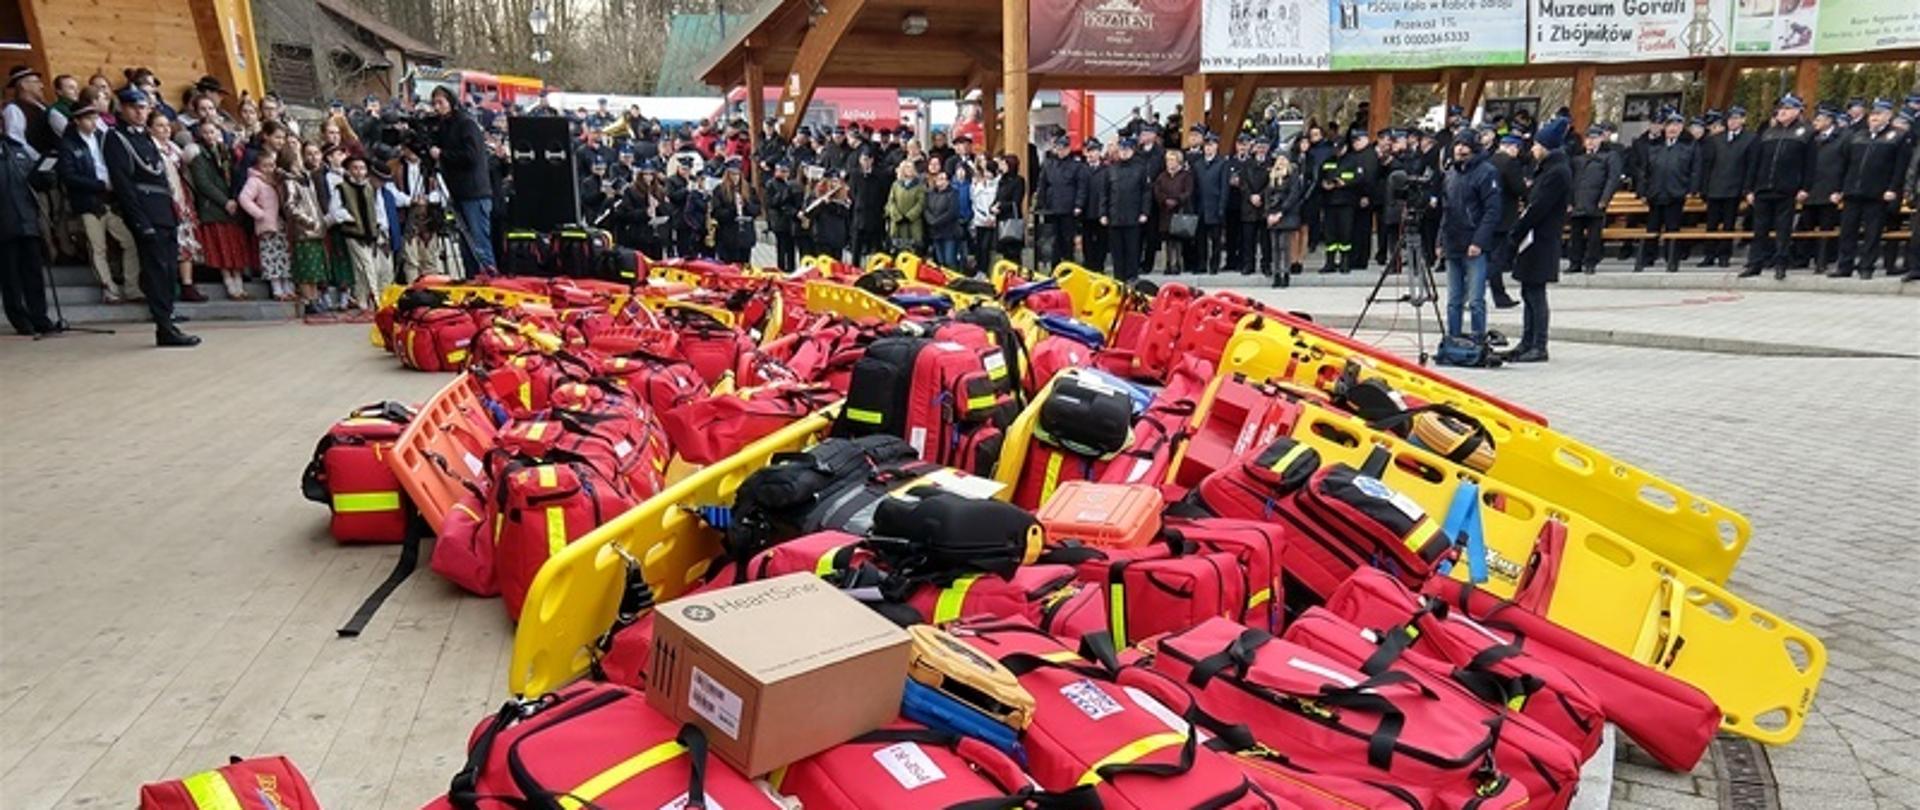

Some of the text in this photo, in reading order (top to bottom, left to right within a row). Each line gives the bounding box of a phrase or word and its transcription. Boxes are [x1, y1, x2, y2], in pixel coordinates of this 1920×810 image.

[1538, 0, 1615, 17] Muzeum
[1537, 23, 1632, 46] i Zbójników
[713, 583, 819, 613] HeartSine
